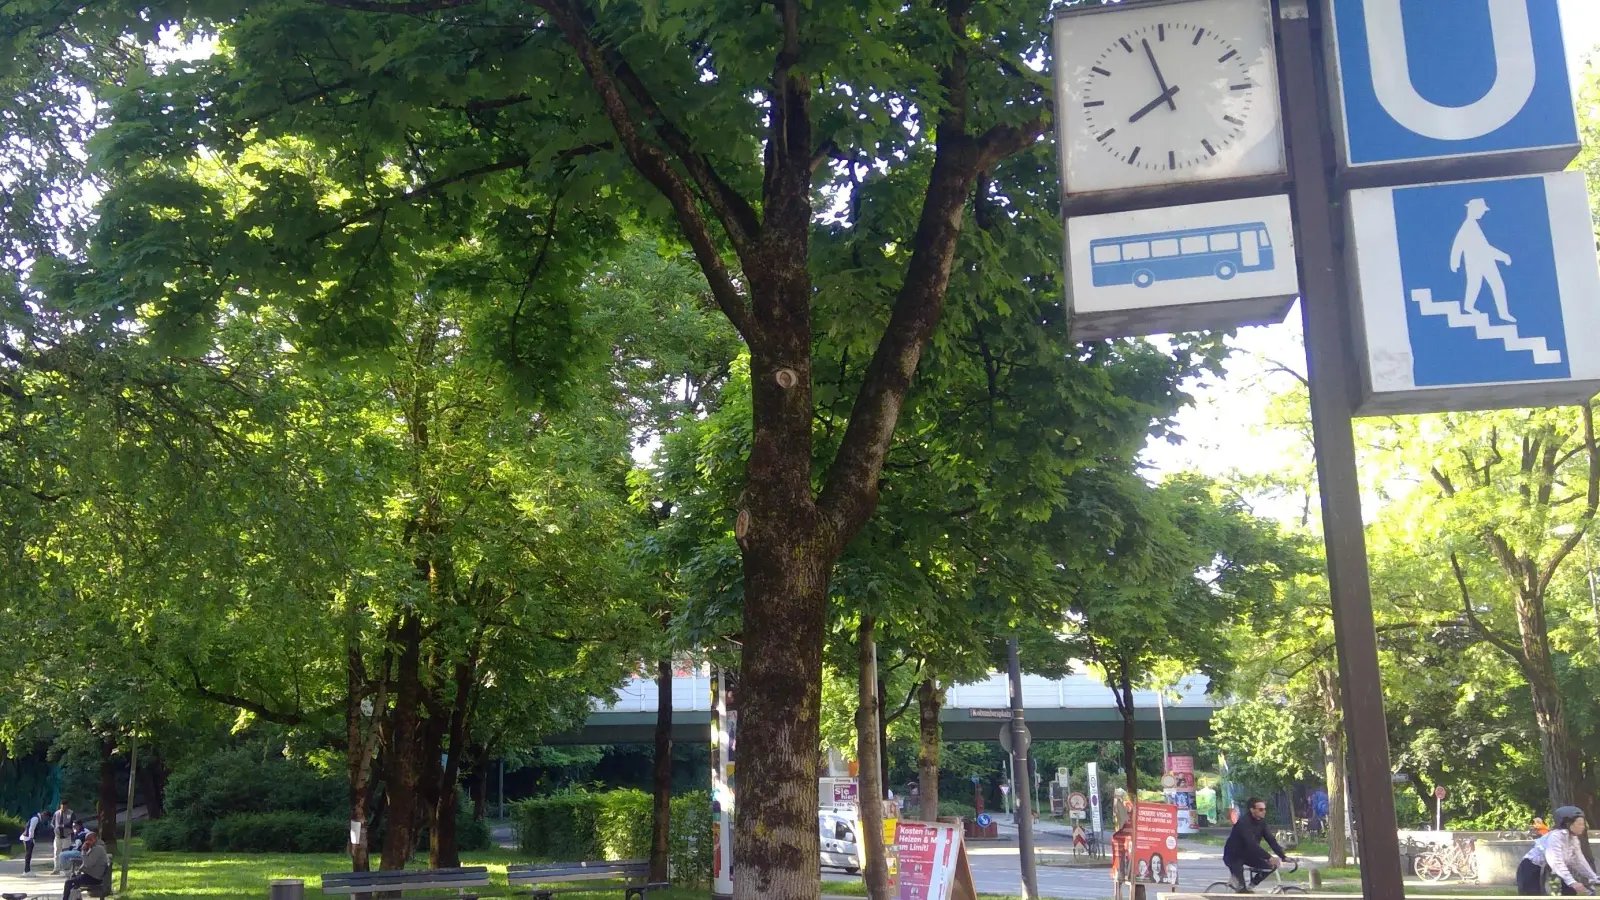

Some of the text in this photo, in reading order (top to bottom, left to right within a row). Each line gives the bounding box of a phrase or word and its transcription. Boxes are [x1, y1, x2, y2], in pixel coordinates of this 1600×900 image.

[1363, 0, 1536, 141] U
[900, 827, 923, 835] Kosten
[899, 835, 922, 843] Heizen
[909, 844, 929, 852] Limit!
